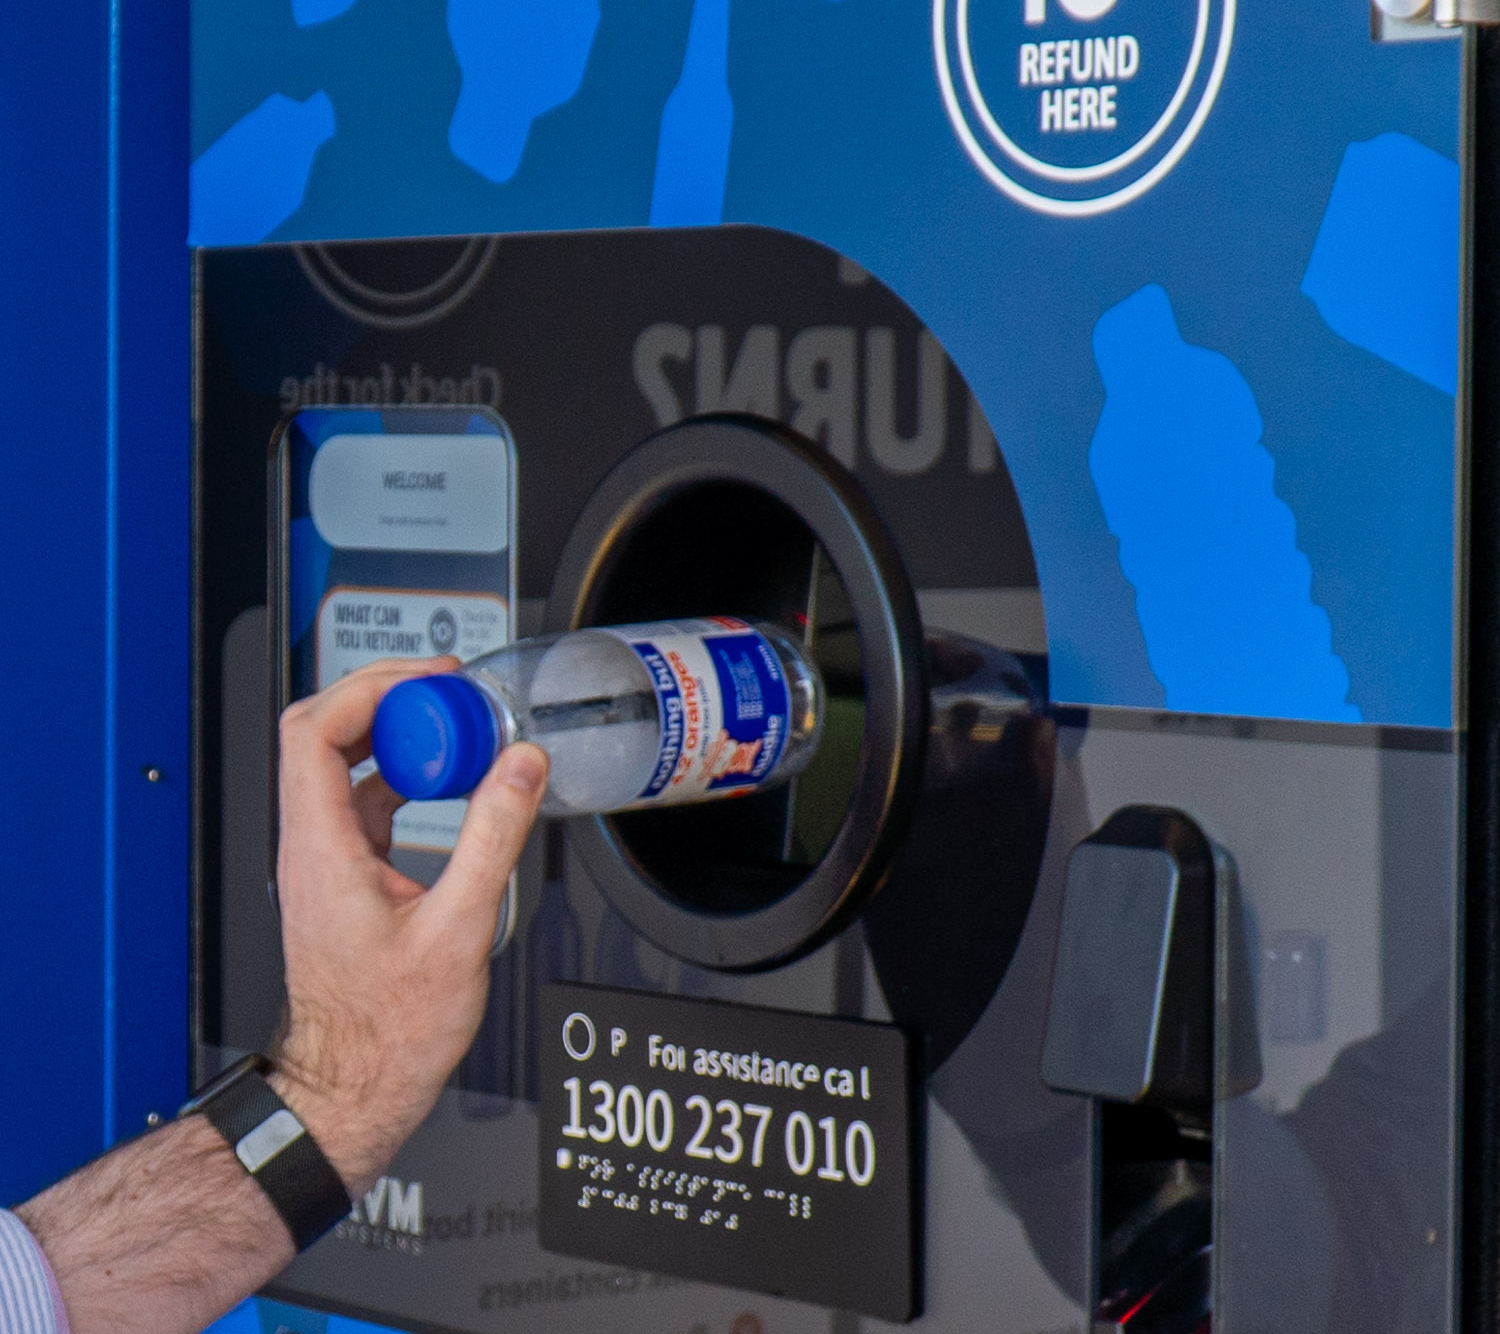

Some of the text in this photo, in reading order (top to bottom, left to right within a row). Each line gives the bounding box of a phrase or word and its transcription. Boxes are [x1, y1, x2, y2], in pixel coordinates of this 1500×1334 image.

[1019, 35, 1139, 85] REFUND
[1040, 84, 1117, 133] HERE
[383, 471, 446, 491] WELCOME
[334, 603, 400, 627] WHAT CAN
[334, 629, 360, 649] YOU
[666, 650, 700, 750] oranges
[692, 1047, 821, 1091] assistance
[562, 1076, 876, 1187] 1300 237 010
